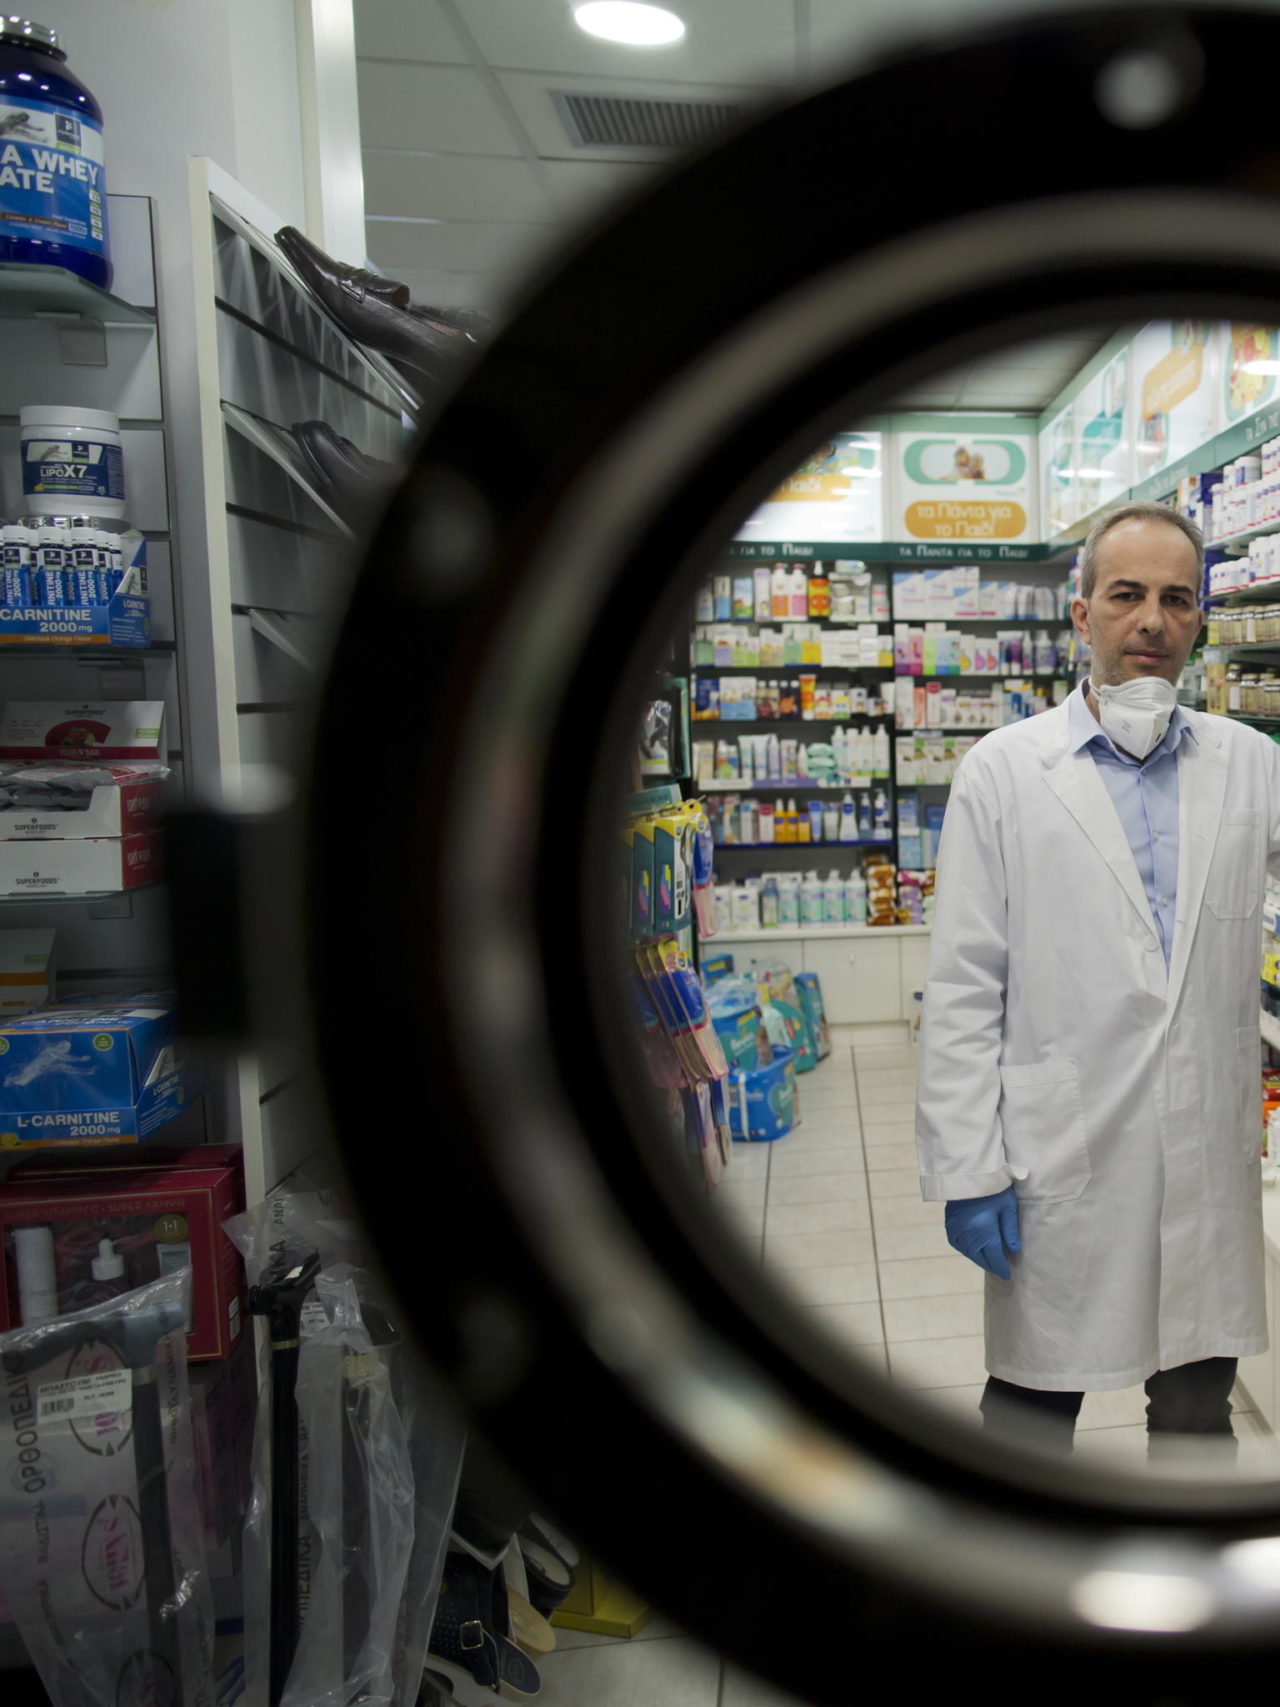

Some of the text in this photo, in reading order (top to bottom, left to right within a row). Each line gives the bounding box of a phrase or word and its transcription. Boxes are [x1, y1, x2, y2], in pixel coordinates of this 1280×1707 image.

[31, 148, 98, 185] WHEY
[917, 505, 934, 519] τα
[937, 502, 986, 519] Πάντα
[934, 520, 994, 537] το Παιδί
[40, 622, 93, 634] 2000 mg
[17, 1111, 120, 1128] L-CARNITINE
[70, 1125, 121, 1136] 2000 mg
